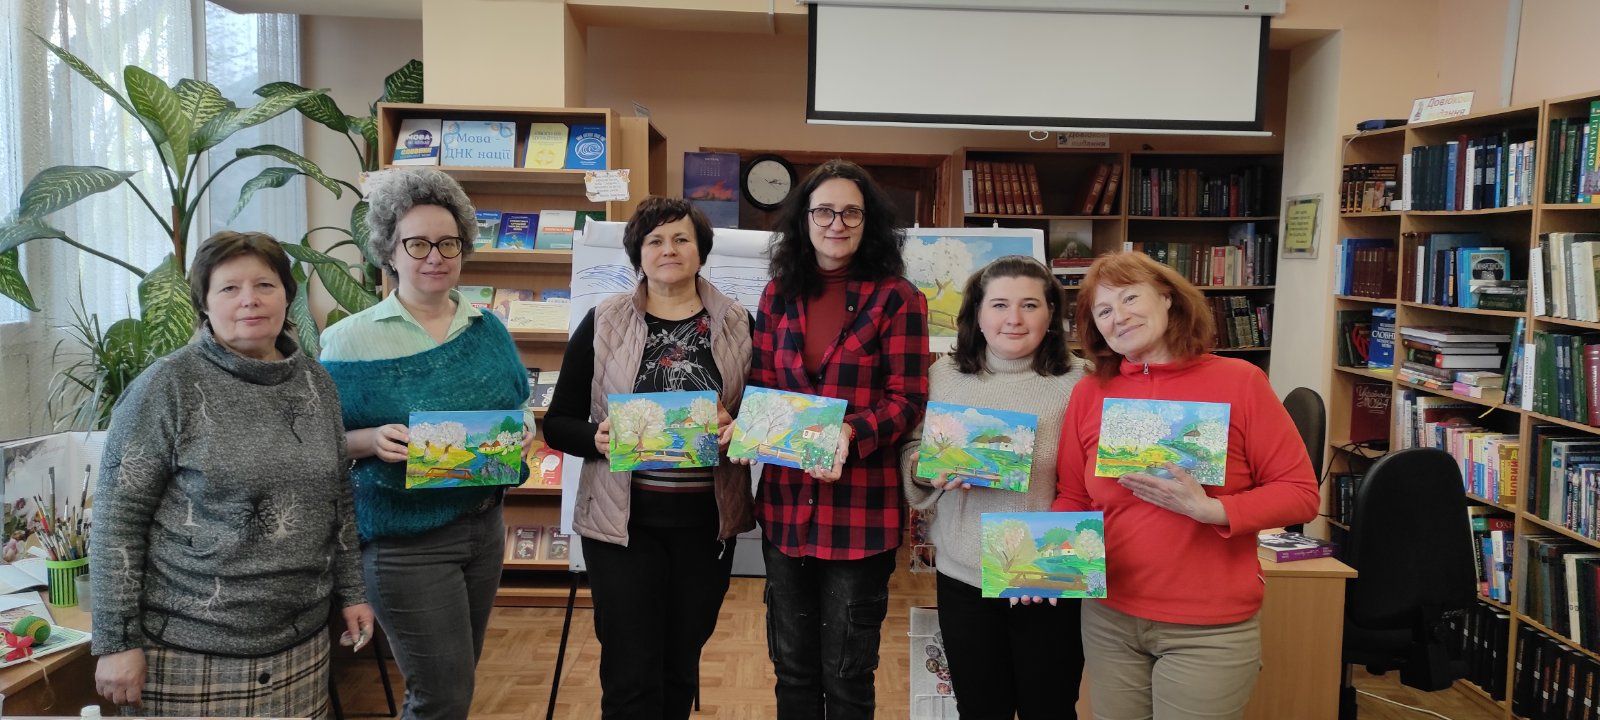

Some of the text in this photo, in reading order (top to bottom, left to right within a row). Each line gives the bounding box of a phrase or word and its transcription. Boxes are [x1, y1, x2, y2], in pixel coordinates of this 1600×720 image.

[456, 133, 492, 144] Мова
[1588, 119, 1598, 166] ITALIANO
[445, 148, 473, 159] ДНК
[478, 149, 511, 160] нації
